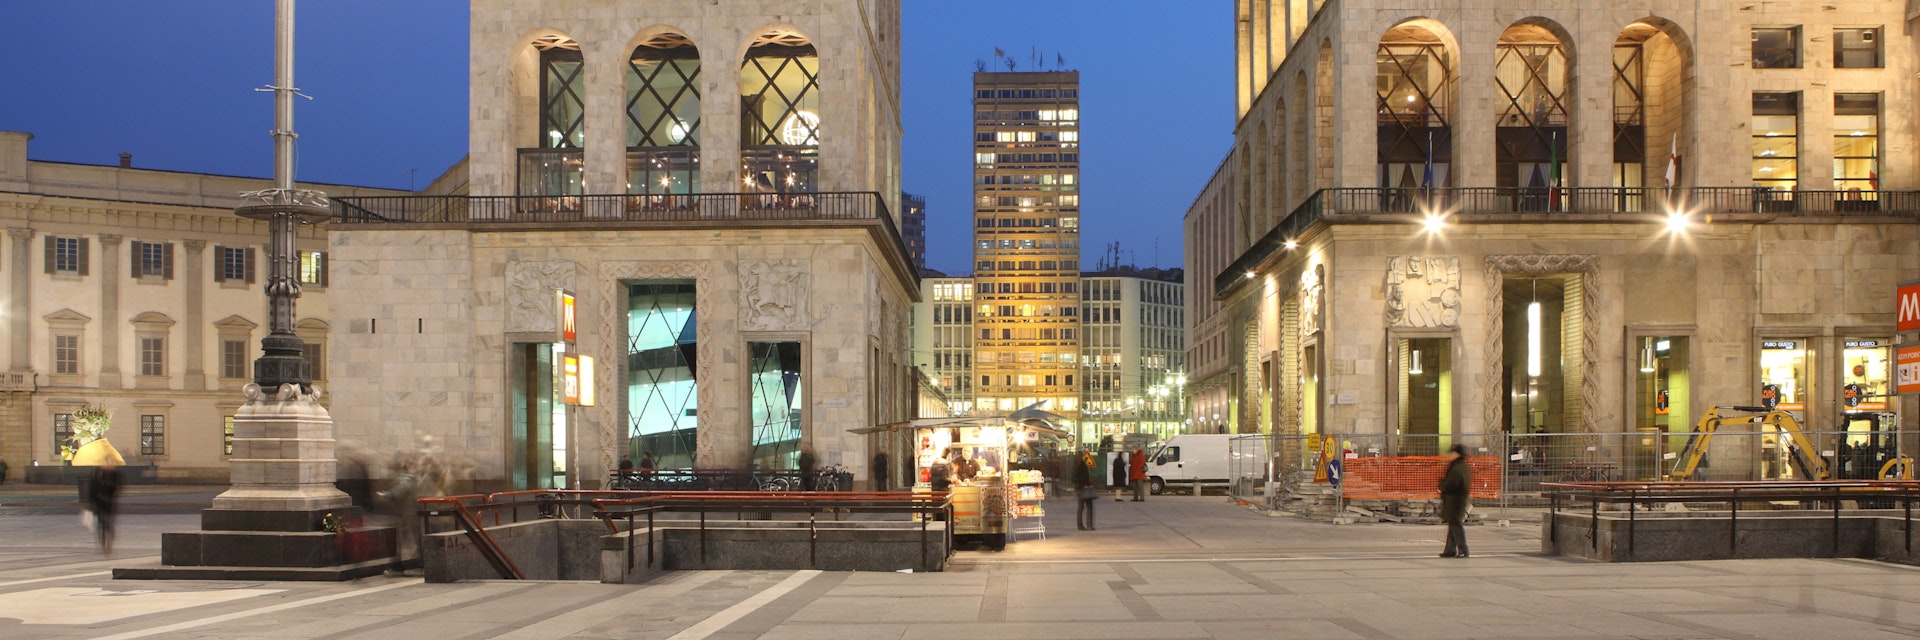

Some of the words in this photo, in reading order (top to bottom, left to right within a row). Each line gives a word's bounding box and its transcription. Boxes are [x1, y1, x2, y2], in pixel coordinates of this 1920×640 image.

[564, 303, 575, 333] M
[1898, 292, 1920, 323] M
[1326, 442, 1334, 454] 30
